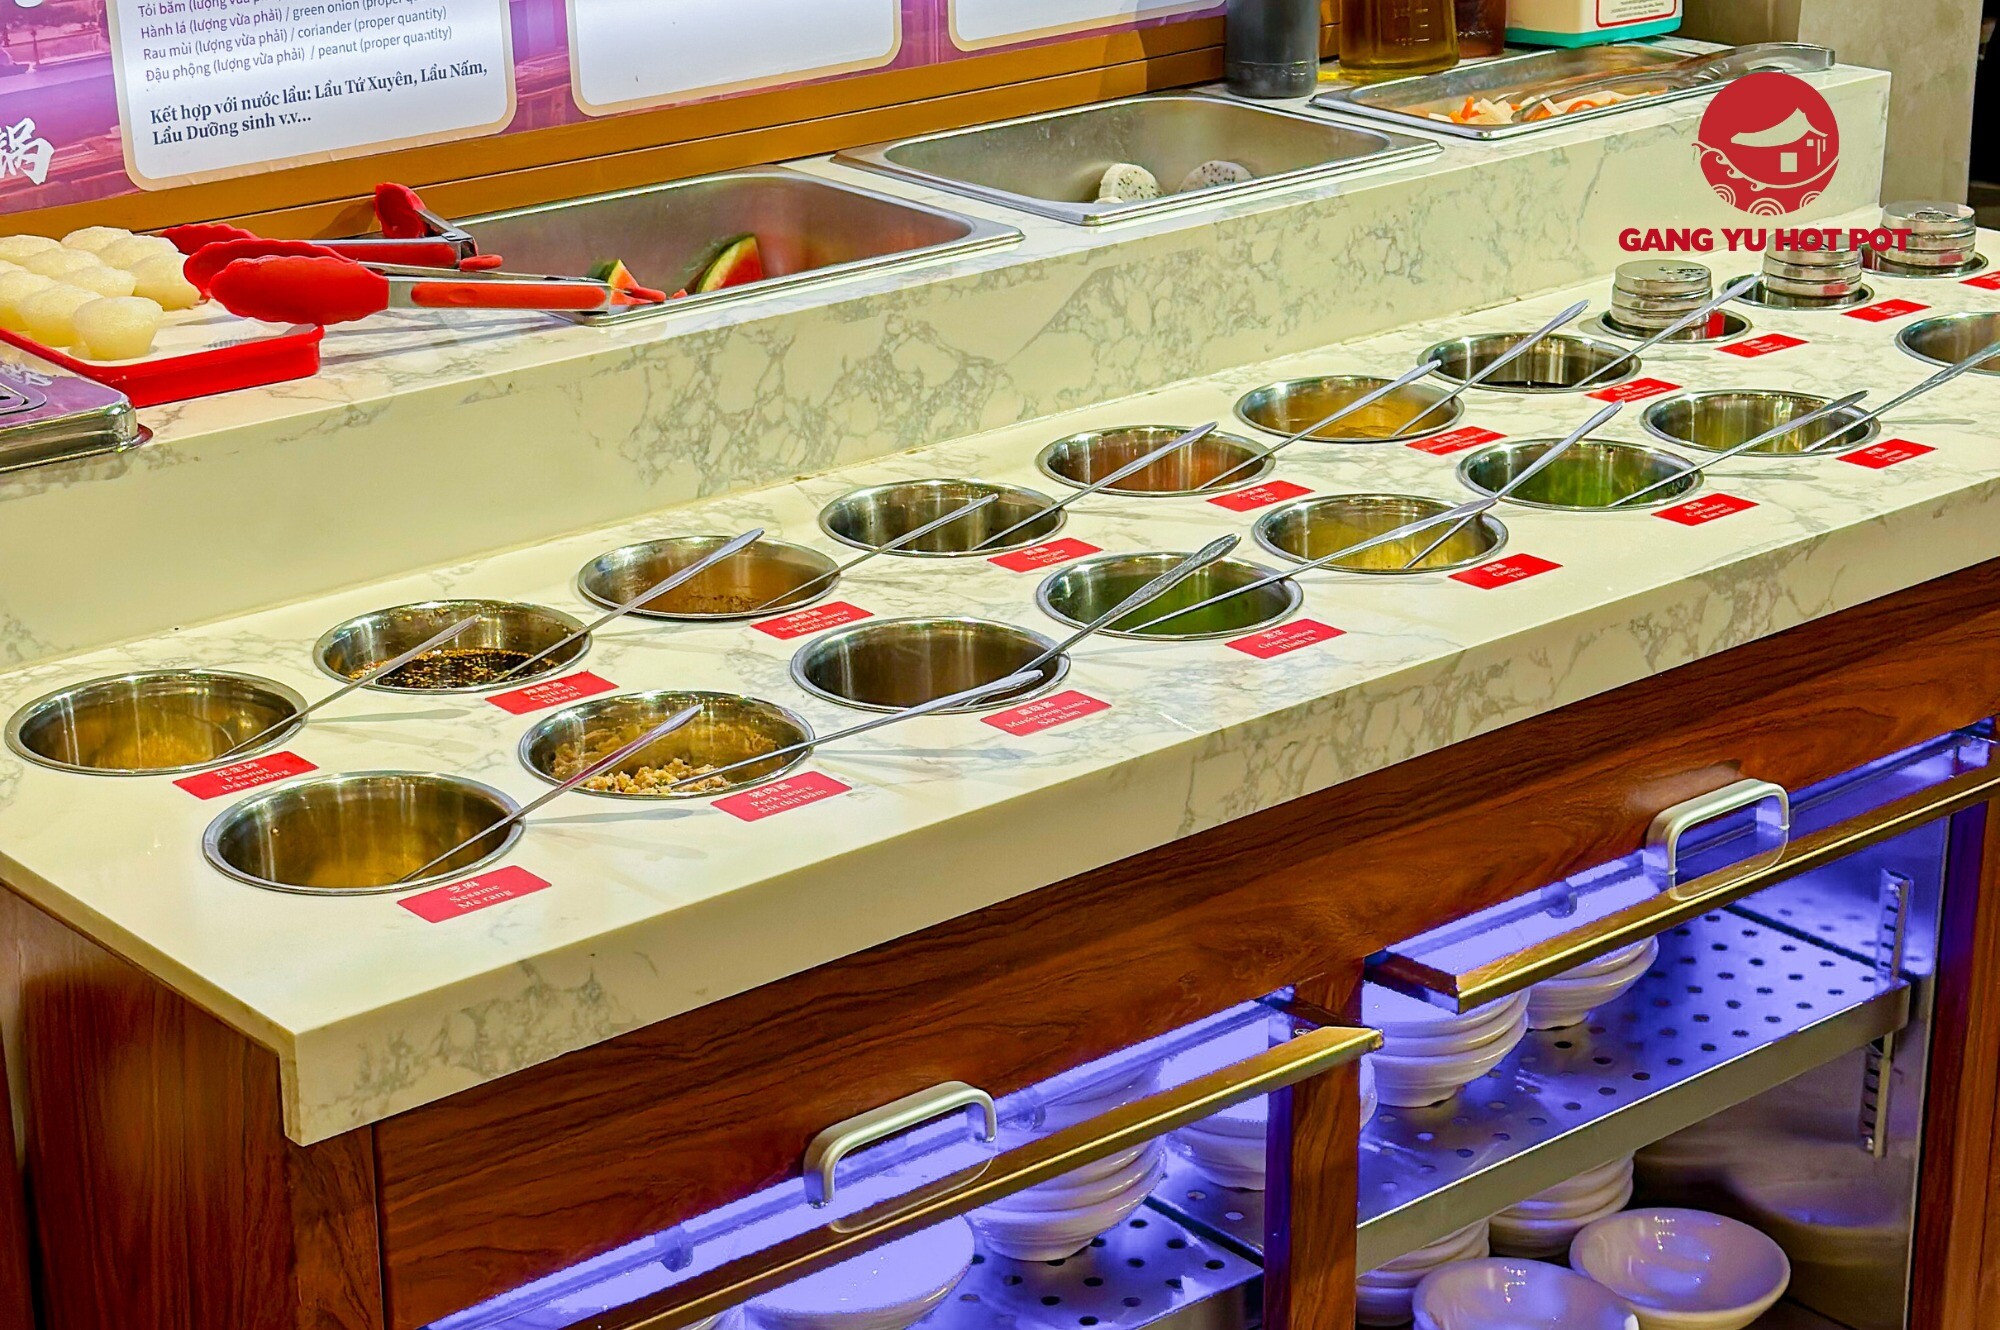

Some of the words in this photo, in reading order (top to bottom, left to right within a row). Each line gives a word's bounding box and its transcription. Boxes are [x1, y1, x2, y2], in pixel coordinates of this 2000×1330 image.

[141, 24, 172, 39] Hành
[176, 21, 186, 34] lá
[190, 18, 227, 34] (lượng
[229, 13, 250, 26] vừa
[254, 8, 282, 26] phải)
[285, 6, 289, 21] /
[293, 5, 324, 20] green
[327, 0, 359, 13] onion
[143, 48, 166, 60] Rau
[169, 42, 192, 57] mùi
[195, 39, 233, 55] (lượng
[235, 33, 256, 47] vừa
[259, 29, 287, 46] phải)
[290, 27, 295, 42] /
[298, 21, 351, 38] coriander
[354, 16, 396, 32] (proper
[397, 6, 447, 26] quantity)
[146, 68, 169, 82] Đậu
[172, 63, 211, 80] phộng
[213, 57, 251, 74] (lượng
[253, 52, 273, 66] vừa
[276, 47, 305, 66] phải)
[310, 45, 315, 60] /
[318, 41, 357, 60] peanut
[360, 36, 401, 52] (proper
[403, 26, 452, 47] quantity)
[150, 105, 178, 124] Kết
[181, 104, 212, 121] hợp
[214, 97, 238, 114] với
[241, 91, 280, 110] nước
[314, 79, 342, 99] Lẩu
[345, 77, 365, 93] Tứ
[367, 71, 417, 91] Xuyên,
[449, 60, 487, 78] Nấm,
[152, 126, 183, 145] Lẩu
[186, 121, 239, 137] Dưỡng
[242, 112, 275, 131] sinh
[225, 768, 270, 783] Peanut
[750, 795, 779, 808] Pork
[781, 785, 814, 799] sauce
[449, 884, 500, 902] Sesame
[483, 889, 515, 902] rang
